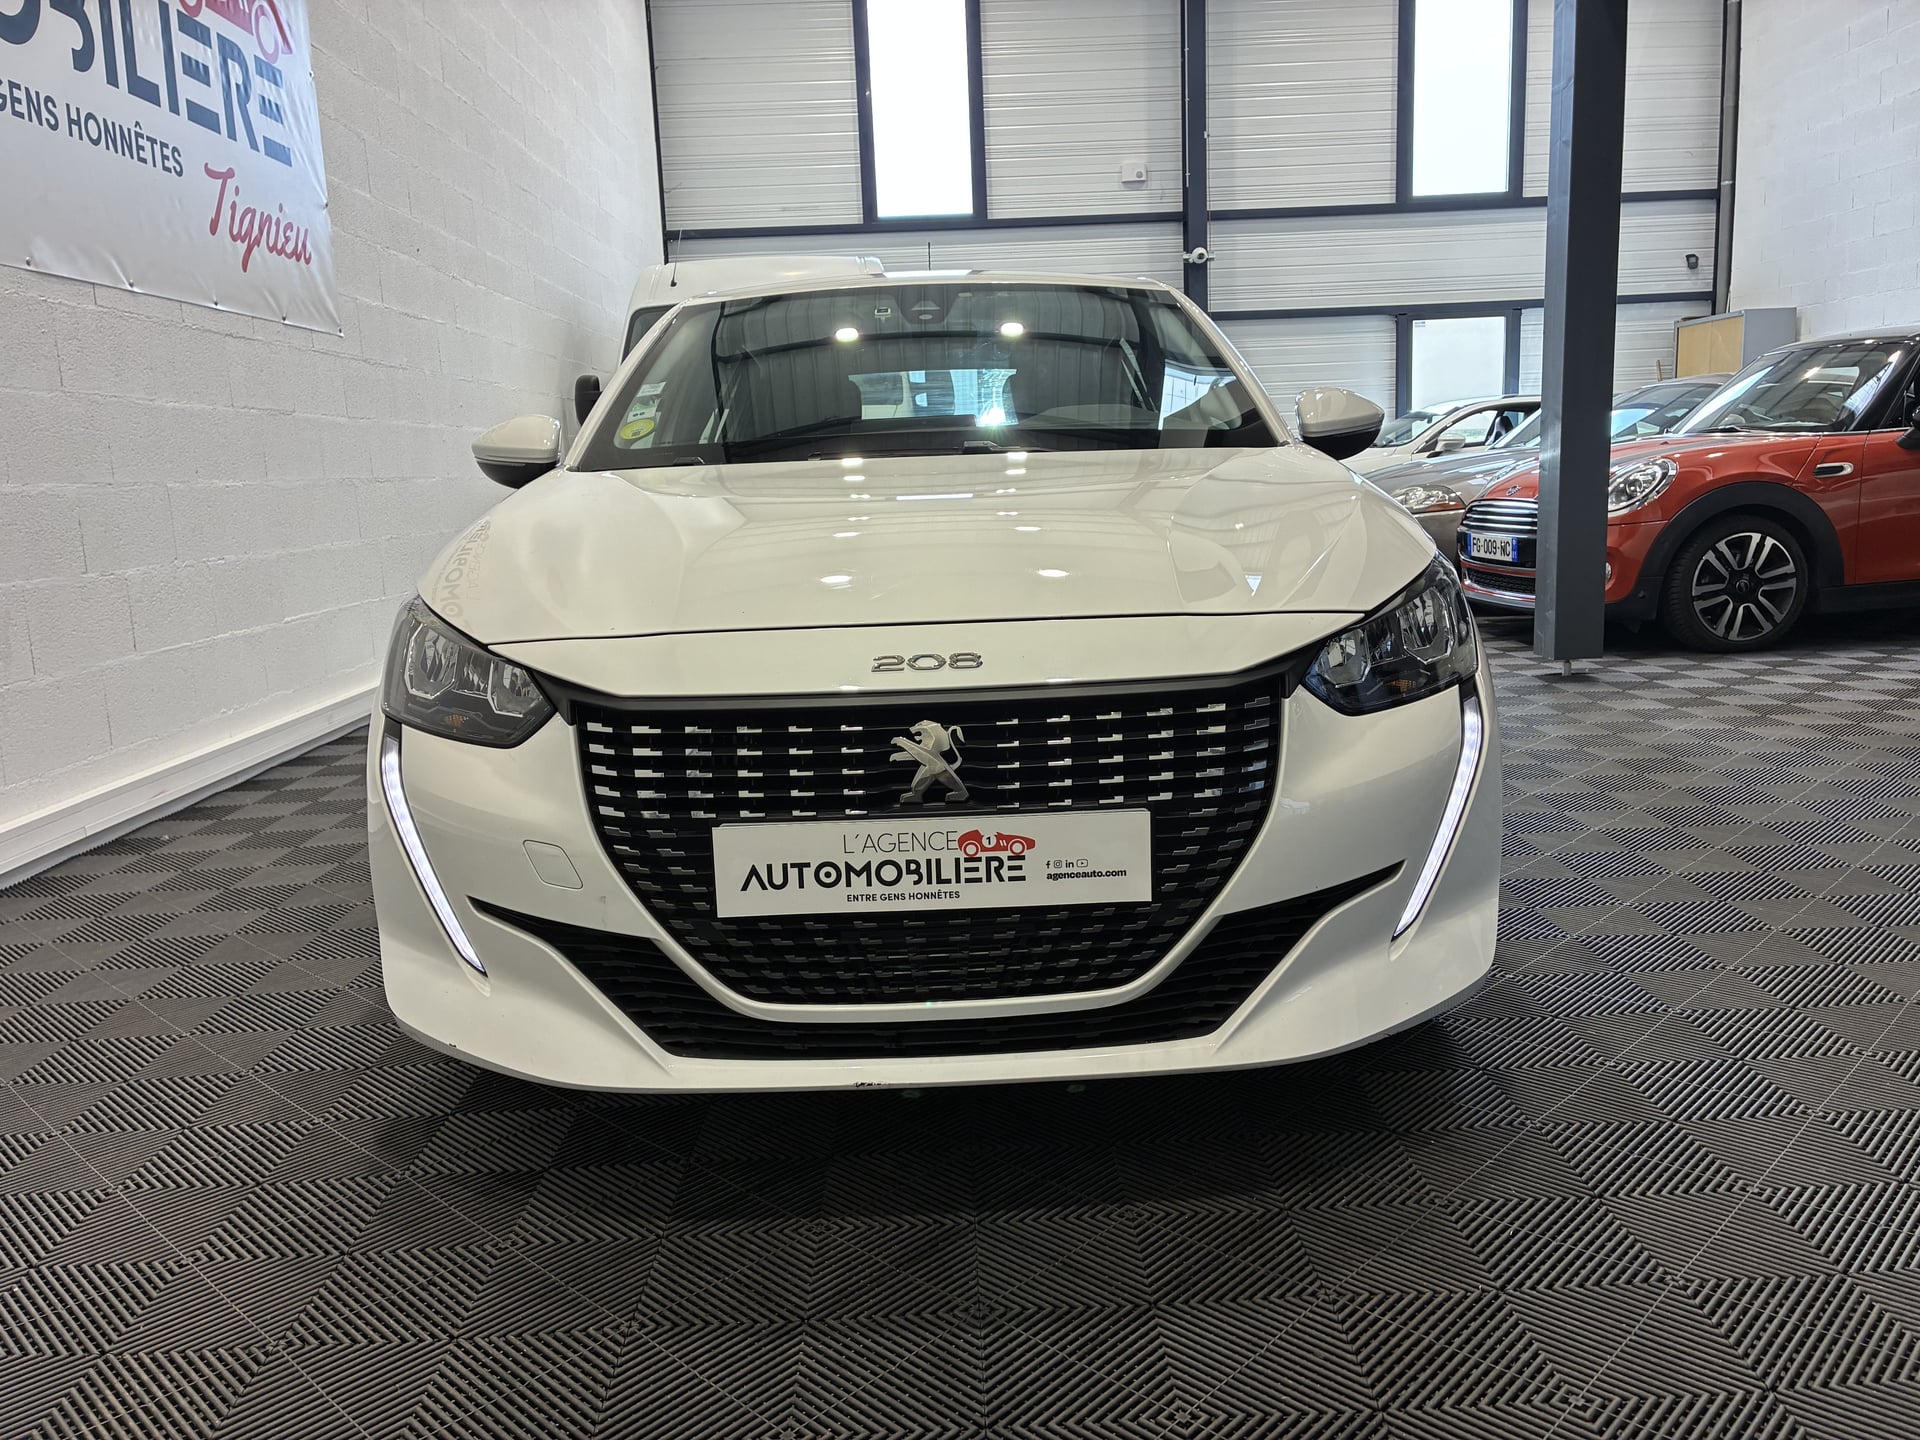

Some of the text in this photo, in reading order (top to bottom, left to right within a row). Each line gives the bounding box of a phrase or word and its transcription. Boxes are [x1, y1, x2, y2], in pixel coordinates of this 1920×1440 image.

[65, 102, 184, 178] HONNÊTES
[204, 162, 312, 273] Tignieu
[1472, 537, 1511, 557] FG-009-NC
[871, 652, 983, 672] 208
[985, 836, 992, 846] 1
[1046, 869, 1127, 881] agenceauto.com
[846, 889, 961, 902] ENTRE GENS HONNÊTES
